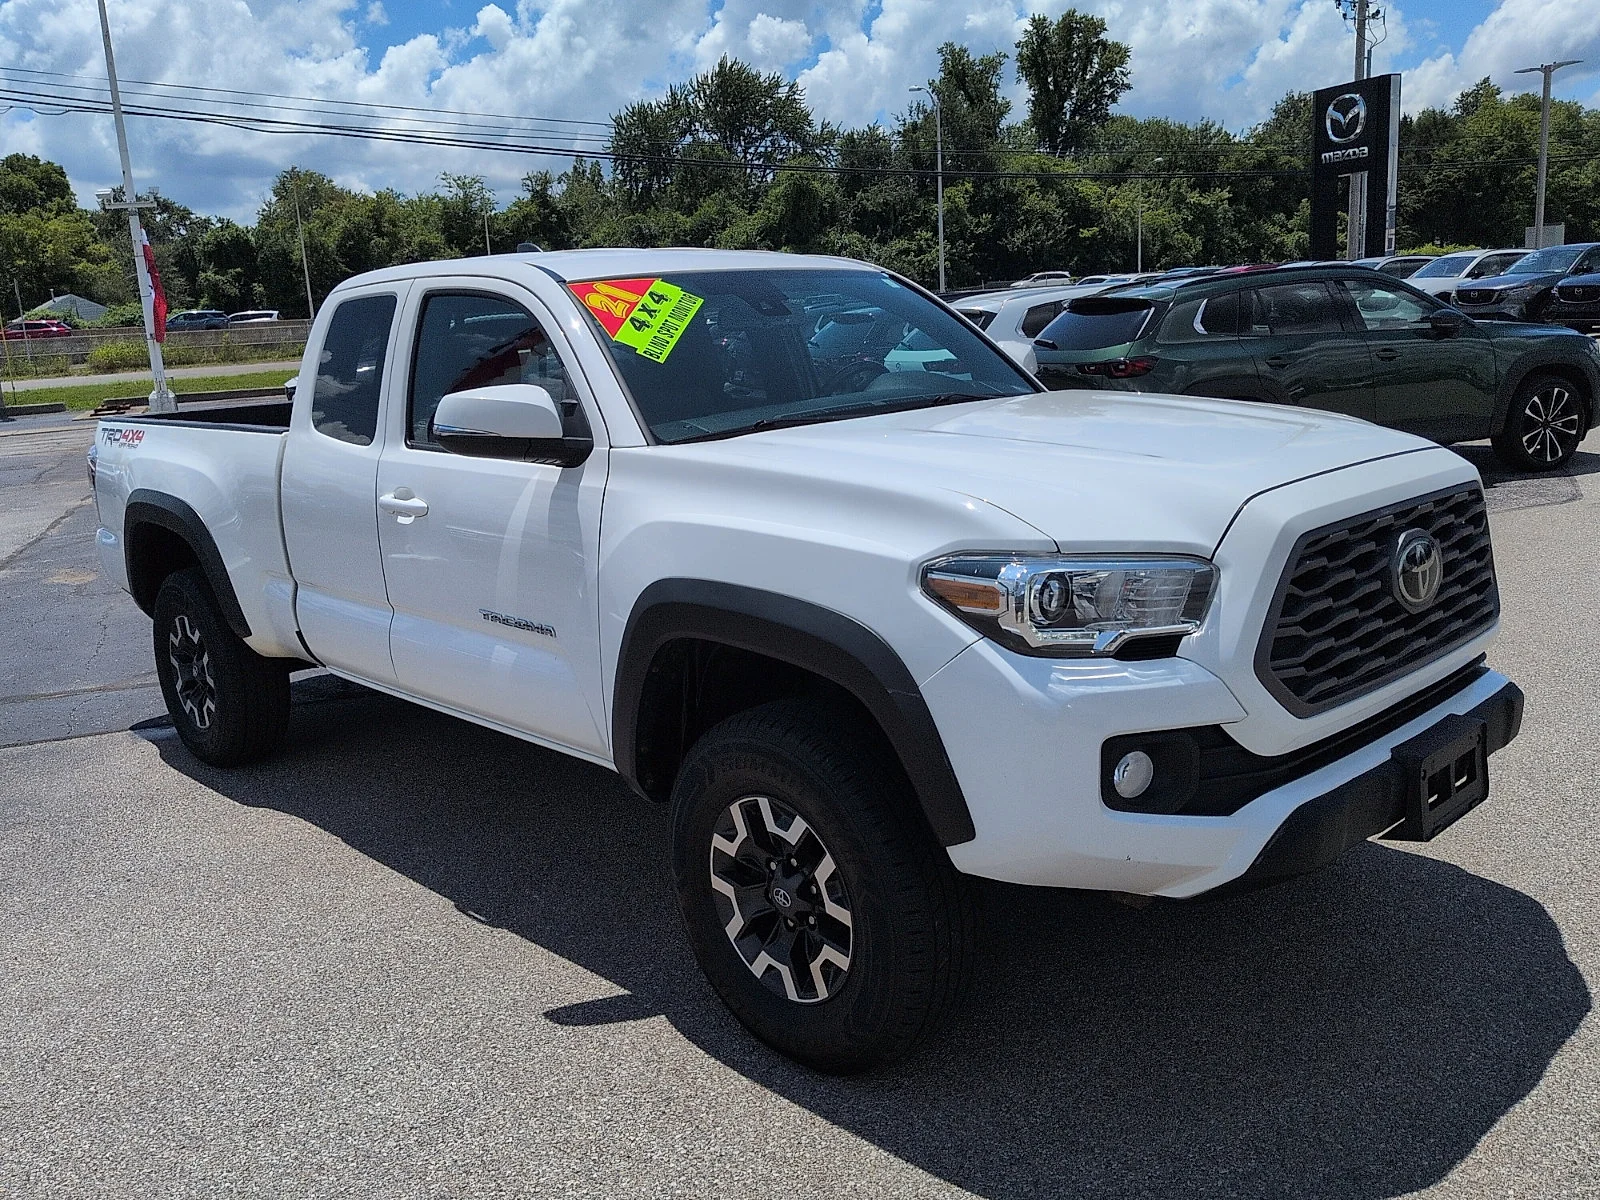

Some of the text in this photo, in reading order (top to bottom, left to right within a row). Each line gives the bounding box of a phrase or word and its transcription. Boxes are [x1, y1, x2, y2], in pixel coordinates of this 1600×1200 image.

[585, 282, 643, 319] 21
[642, 293, 699, 360] BLIND SPOT MONITOR
[479, 608, 557, 638] TACOMA
